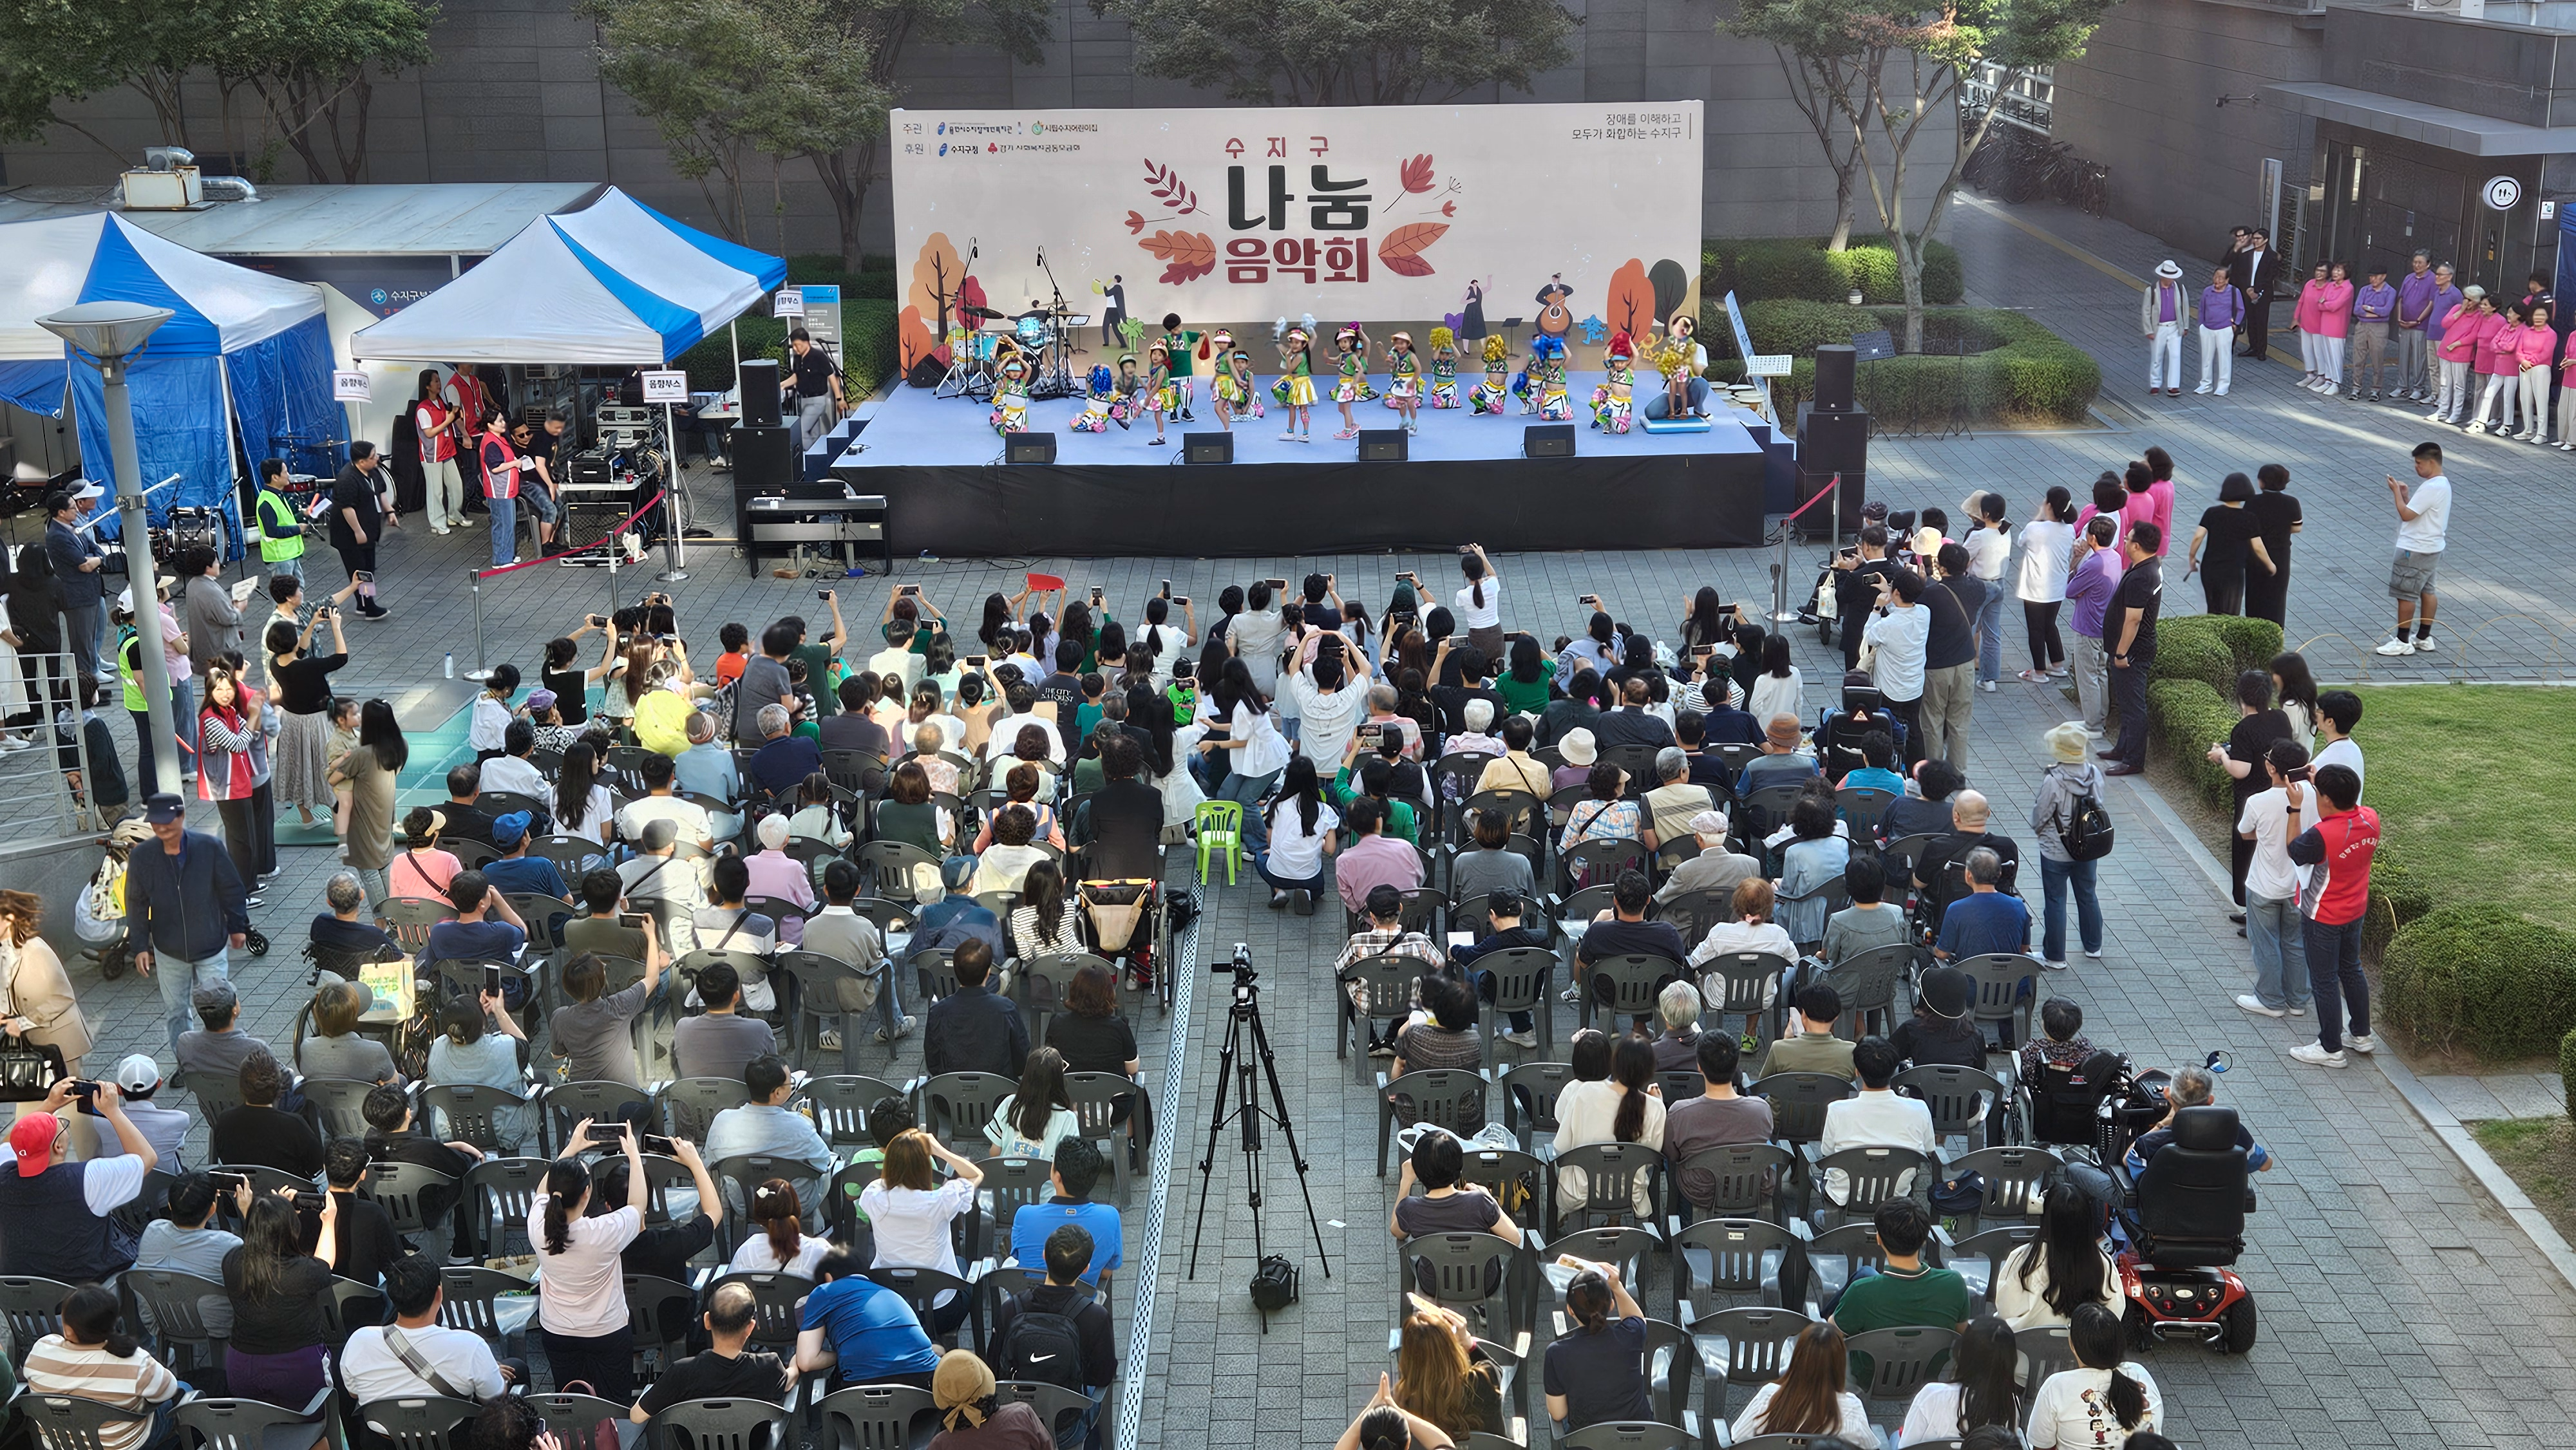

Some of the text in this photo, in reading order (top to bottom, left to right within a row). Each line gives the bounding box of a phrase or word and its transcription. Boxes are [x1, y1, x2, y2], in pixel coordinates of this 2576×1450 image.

[1606, 113, 1681, 126] 장애를 이해하고
[903, 123, 922, 135] 주관
[1572, 127, 1681, 140] 모두가 화합하는 수지구
[905, 144, 923, 155] 후원
[951, 146, 978, 154] 수지구청
[1227, 164, 1372, 231] 나눔
[1224, 236, 1370, 284] 음악회
[391, 290, 432, 301] 수지구보
